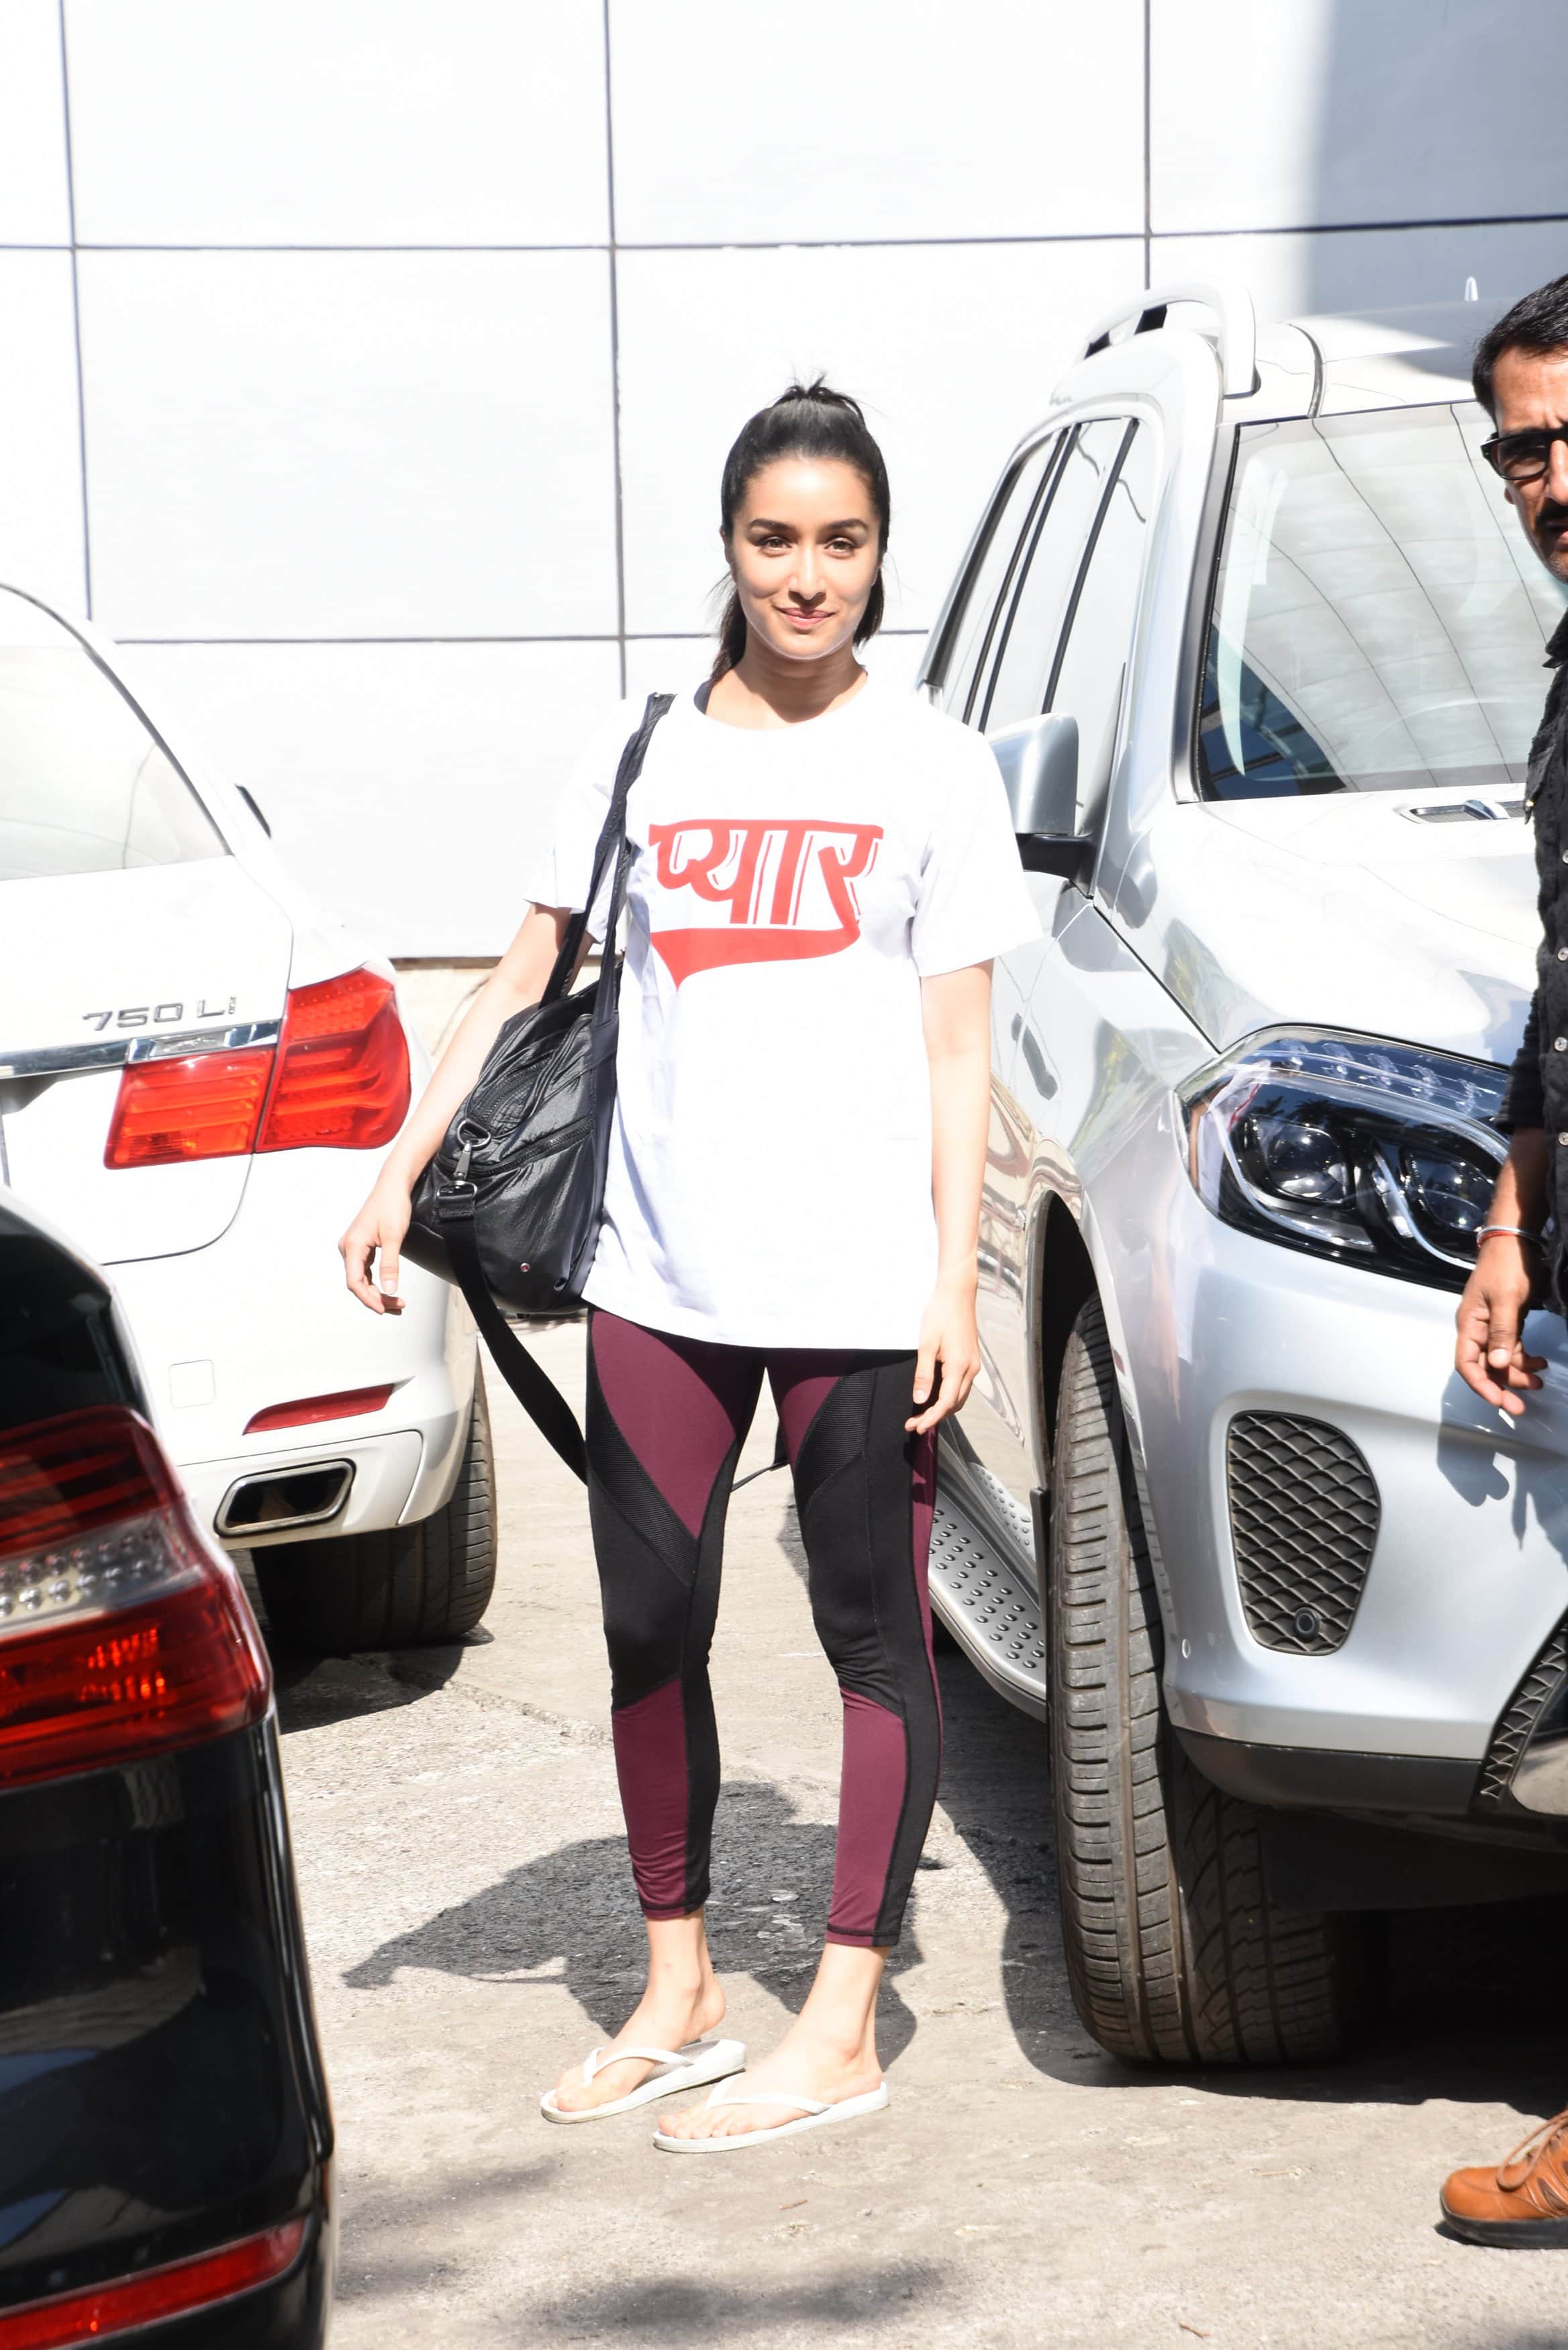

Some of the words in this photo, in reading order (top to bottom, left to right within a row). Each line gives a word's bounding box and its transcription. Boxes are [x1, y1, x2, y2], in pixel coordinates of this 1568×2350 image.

[648, 819, 883, 940] प्यार
[83, 1002, 183, 1031] 750
[197, 996, 236, 1019] Li
